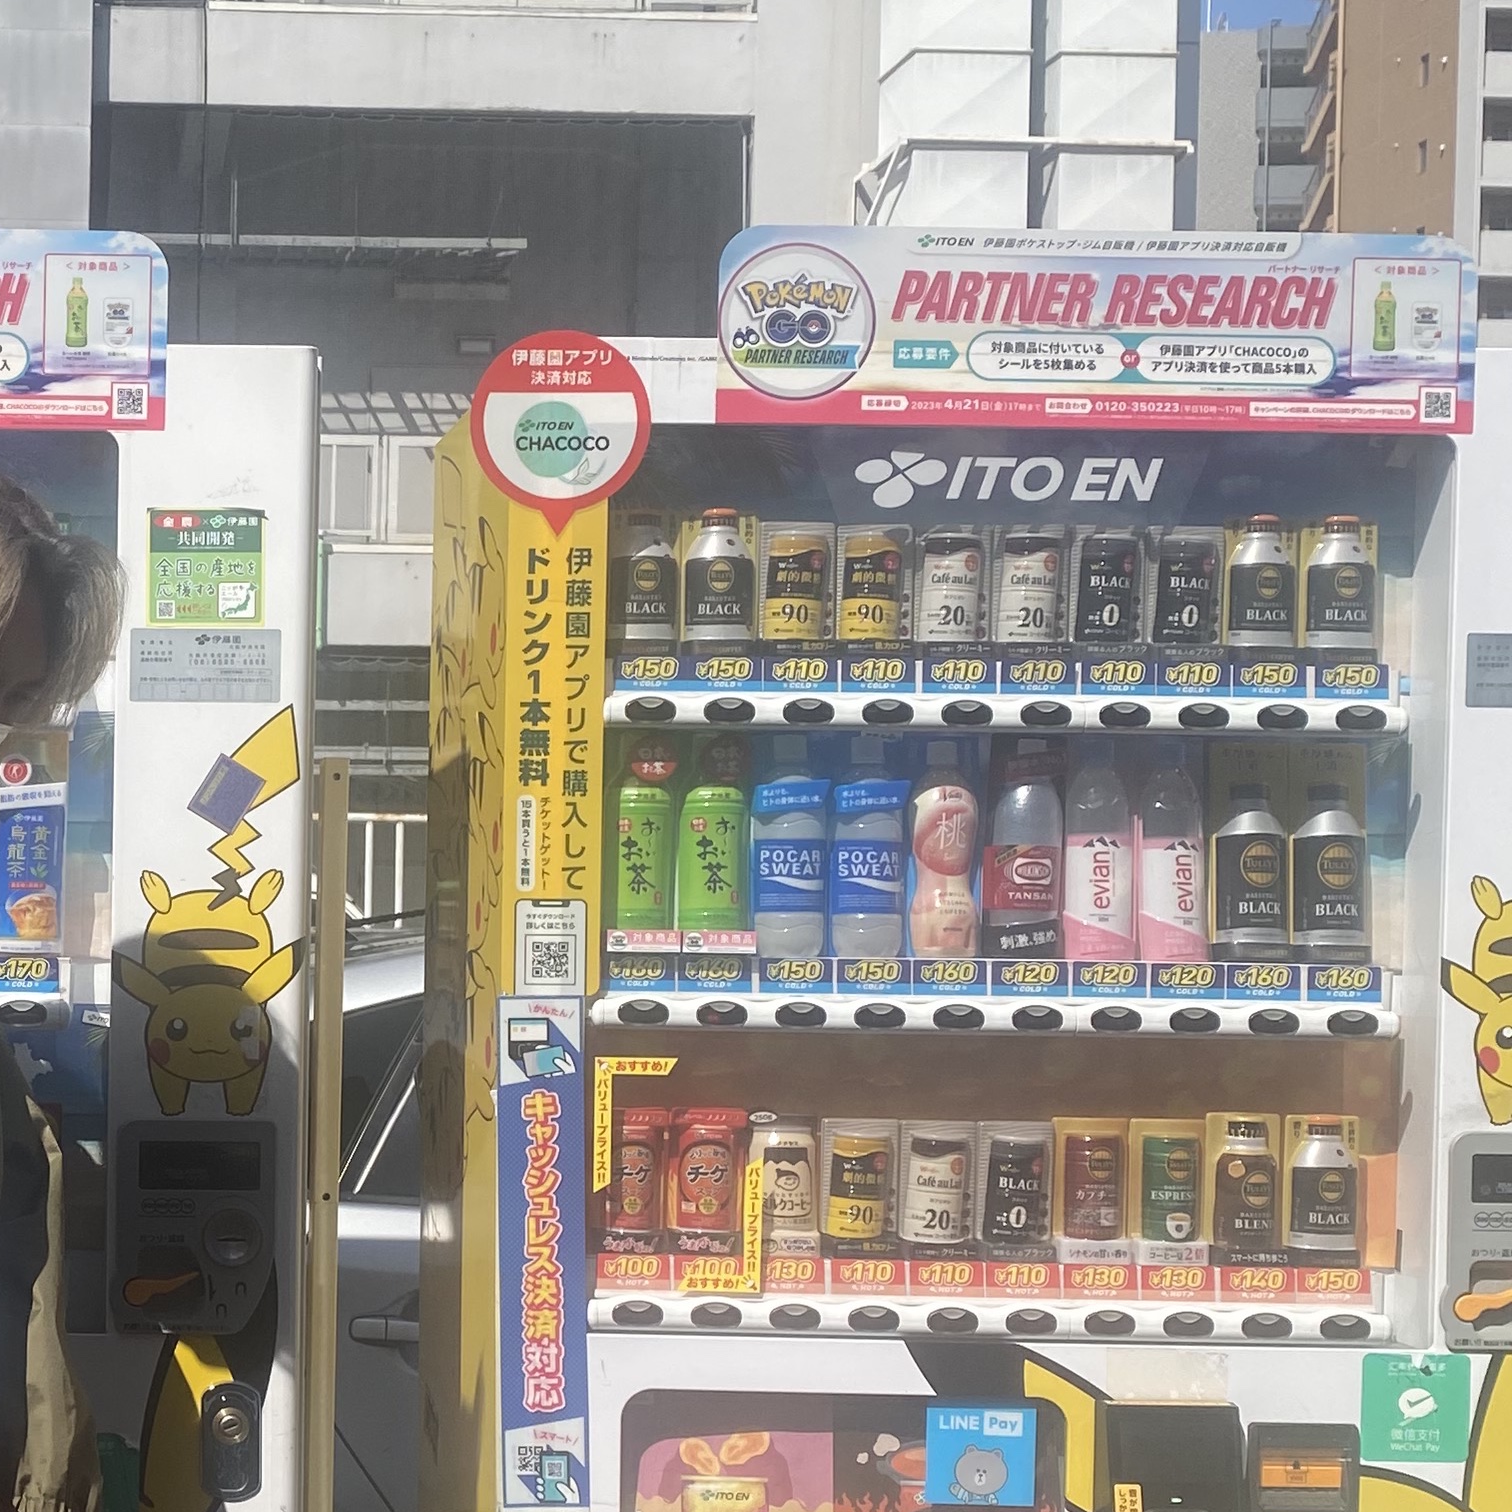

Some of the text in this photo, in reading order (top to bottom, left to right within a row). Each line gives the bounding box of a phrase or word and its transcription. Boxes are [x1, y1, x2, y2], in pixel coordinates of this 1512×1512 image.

[891, 270, 1338, 330] PARTNER RESEARCH
[766, 311, 831, 345] GO
[512, 349, 613, 367] 伊藤園アプリ
[745, 348, 847, 364] PARTNER RESEARCH
[897, 346, 952, 360] 応募要件
[991, 341, 1105, 355] 対象商品に付いている
[1159, 344, 1310, 359] 伊藤園アプリ「CHACOCO」の
[998, 357, 1097, 371] シールを5枚集める
[1124, 354, 1137, 364] or
[1151, 360, 1318, 375] アプリ決済を使って商品5本購入
[531, 370, 592, 386] 決済対応
[1095, 401, 1180, 413] 0120-350223
[536, 421, 574, 431] ITO EN
[516, 436, 610, 451] CHACOCO
[946, 456, 1164, 501] ITO EN
[177, 531, 235, 546] 共同開発
[155, 558, 256, 578] 全国の産地を
[156, 580, 215, 599] 応援する
[1090, 575, 1131, 588] BLACK
[1170, 576, 1210, 590] BLACK
[625, 602, 667, 614] BLACK
[698, 603, 741, 615] BLACK
[782, 604, 808, 624] 90
[857, 604, 884, 625] 90
[938, 605, 964, 626] 20
[1017, 606, 1044, 628] 20
[1246, 609, 1287, 621] BLACK
[1325, 609, 1368, 621] BLACK
[519, 547, 552, 786] ドリンク1本無料
[696, 657, 753, 681] ¥150
[851, 658, 906, 682] ¥110
[1010, 660, 1066, 684] ¥110
[1166, 661, 1220, 686] ¥110
[1322, 664, 1380, 688] ¥150
[561, 547, 593, 890] 伊藤園アプリで購入して
[937, 812, 967, 850] 桃
[6, 825, 27, 878] 烏龍茶
[31, 826, 51, 860] 黄金
[621, 836, 656, 894] お茶
[697, 836, 732, 893] お茶
[760, 863, 821, 876] SWEAT
[838, 864, 900, 876] SWEAT
[1089, 850, 1110, 909] evian
[1173, 853, 1193, 913] evian
[1008, 892, 1054, 900] TANSAN
[1239, 901, 1281, 915] BLACK
[1315, 903, 1359, 917] BLACK
[632, 933, 677, 944] 対象商品
[708, 934, 753, 944] 対象商品
[685, 957, 742, 981] ¥160
[845, 961, 901, 983] ¥150
[1001, 963, 1058, 985] ¥120
[1159, 965, 1216, 988] ¥120
[1315, 967, 1372, 991] ¥160
[615, 1060, 668, 1072] おすすめ!
[596, 1078, 609, 1184] バリュープライス!!
[999, 1176, 1040, 1190] BLACK
[747, 1167, 762, 1273] バリュープライス!!
[923, 1209, 950, 1230] 20
[1308, 1212, 1351, 1225] BLACK
[522, 1090, 565, 1413] キャッシュレス決済対応
[841, 1261, 895, 1283] ¥110
[994, 1264, 1049, 1287] ¥110
[1149, 1266, 1206, 1290] ¥130
[1304, 1269, 1362, 1293] ¥150
[686, 1278, 740, 1290] おすすめ!
[938, 1414, 1019, 1436] LINE Pay
[1390, 1443, 1440, 1453] WeChat Pay
[715, 1492, 750, 1501] ITO EN
